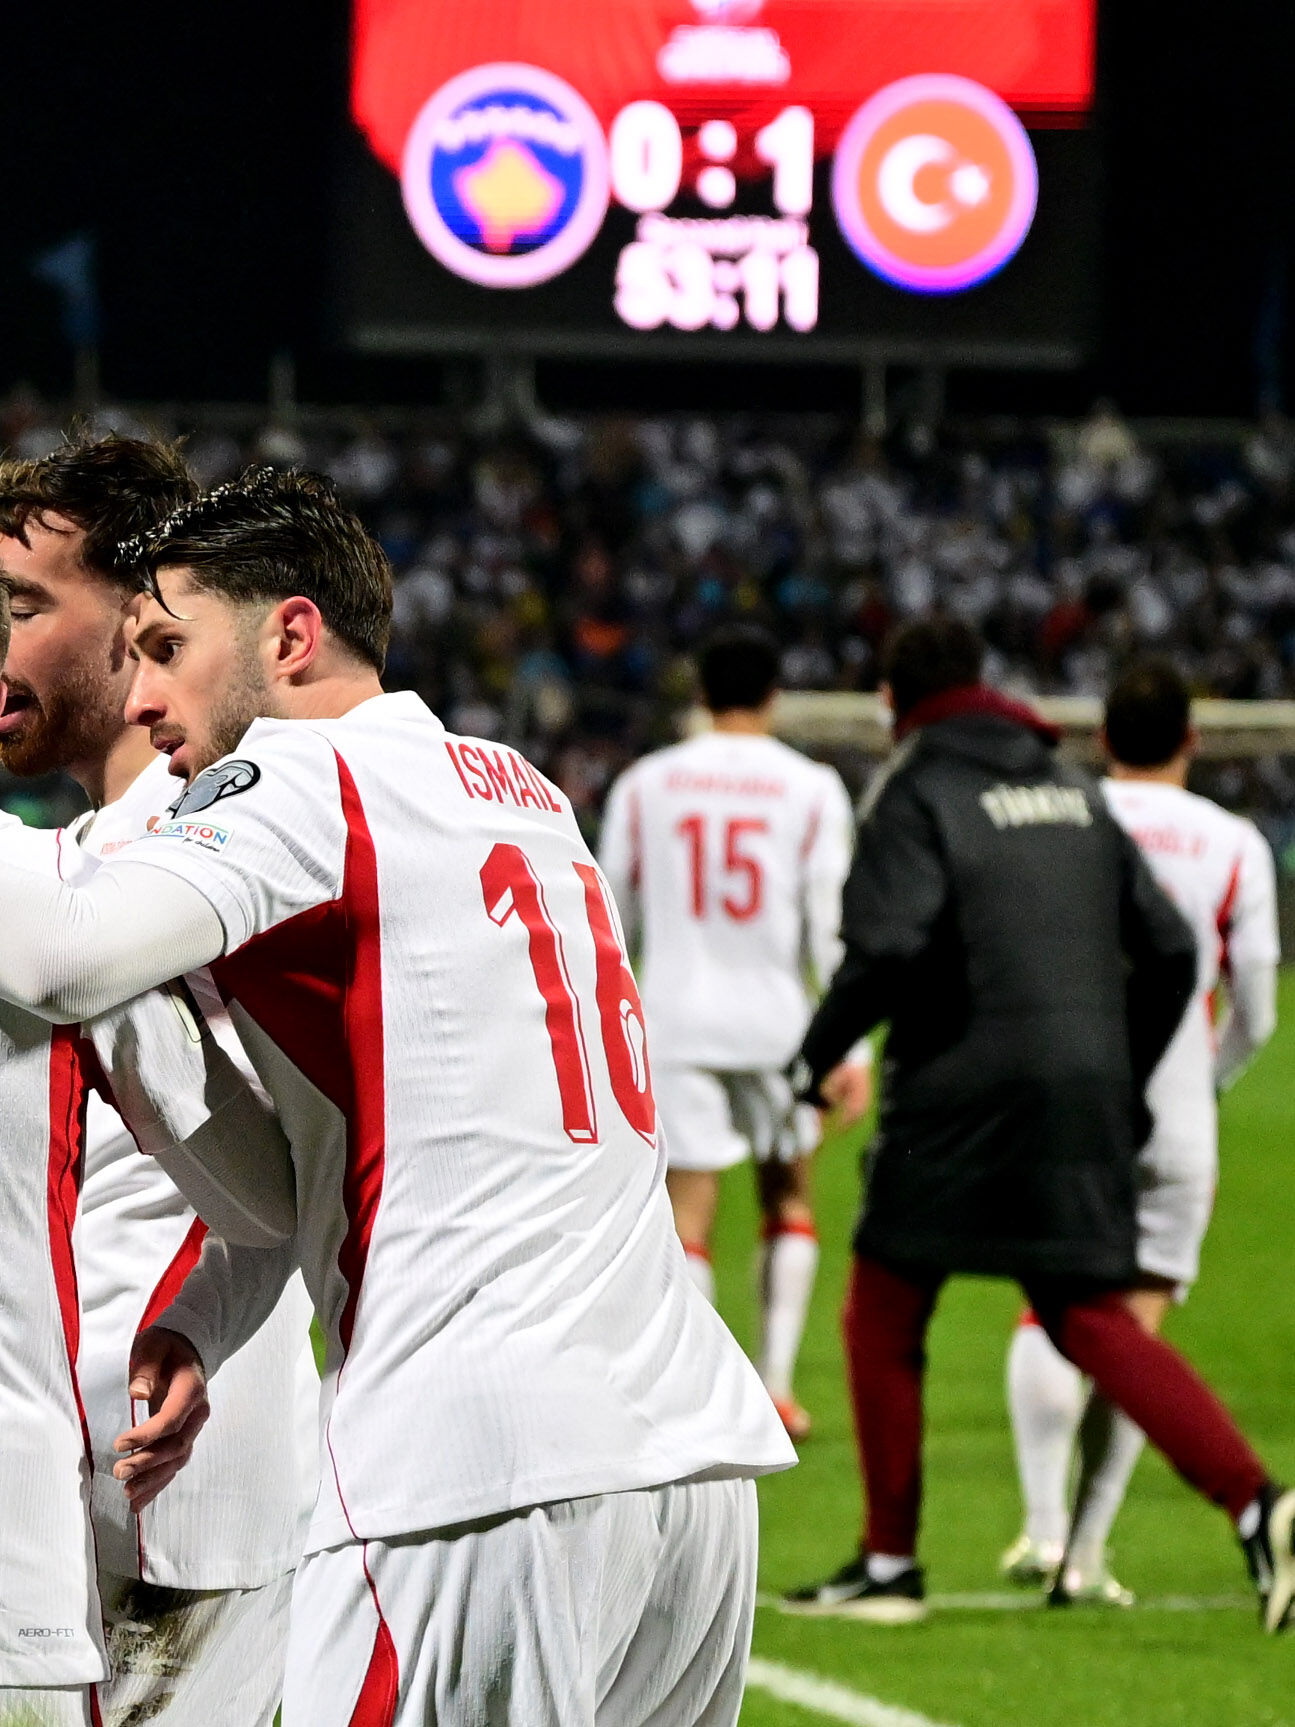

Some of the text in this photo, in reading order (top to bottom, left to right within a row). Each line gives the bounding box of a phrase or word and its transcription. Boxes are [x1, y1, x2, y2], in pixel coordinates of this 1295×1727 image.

[444, 741, 562, 813] ISMAIL
[674, 815, 768, 920] 15
[479, 843, 655, 1149] 16
[18, 1627, 74, 1638] AERO-FIT
